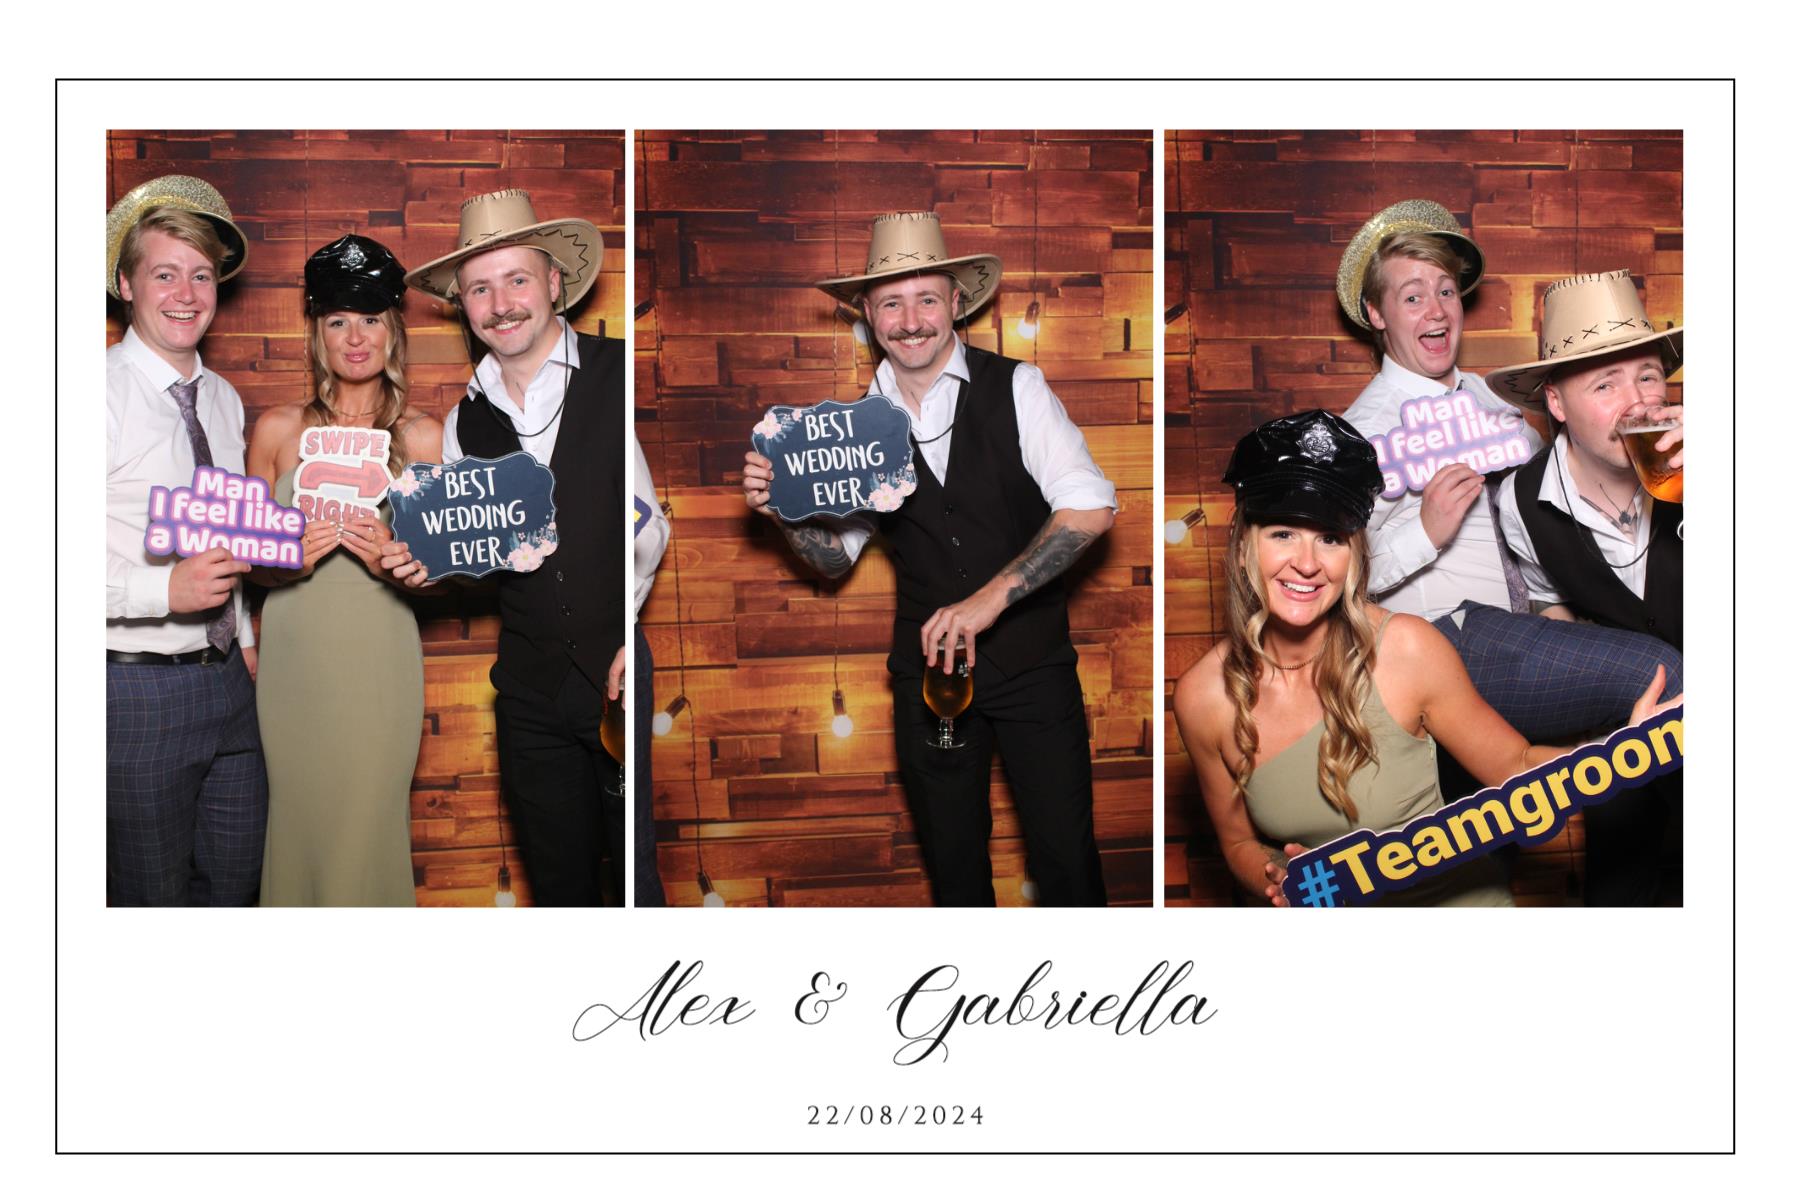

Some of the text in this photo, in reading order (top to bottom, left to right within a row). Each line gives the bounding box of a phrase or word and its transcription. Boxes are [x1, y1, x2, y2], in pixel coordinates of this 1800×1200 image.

[805, 410, 854, 441] BEST
[1406, 395, 1473, 429] Man
[305, 431, 386, 458] SWIPE
[1375, 410, 1519, 463] I feel like
[784, 441, 885, 476] WEDDING
[198, 471, 264, 501] Man
[445, 467, 496, 499] BEST
[813, 477, 865, 508] EVER
[1383, 472, 1401, 492] a
[155, 492, 301, 533] I feel like
[421, 500, 526, 535] WEDDING
[150, 527, 170, 549] a
[450, 536, 504, 567] EVER
